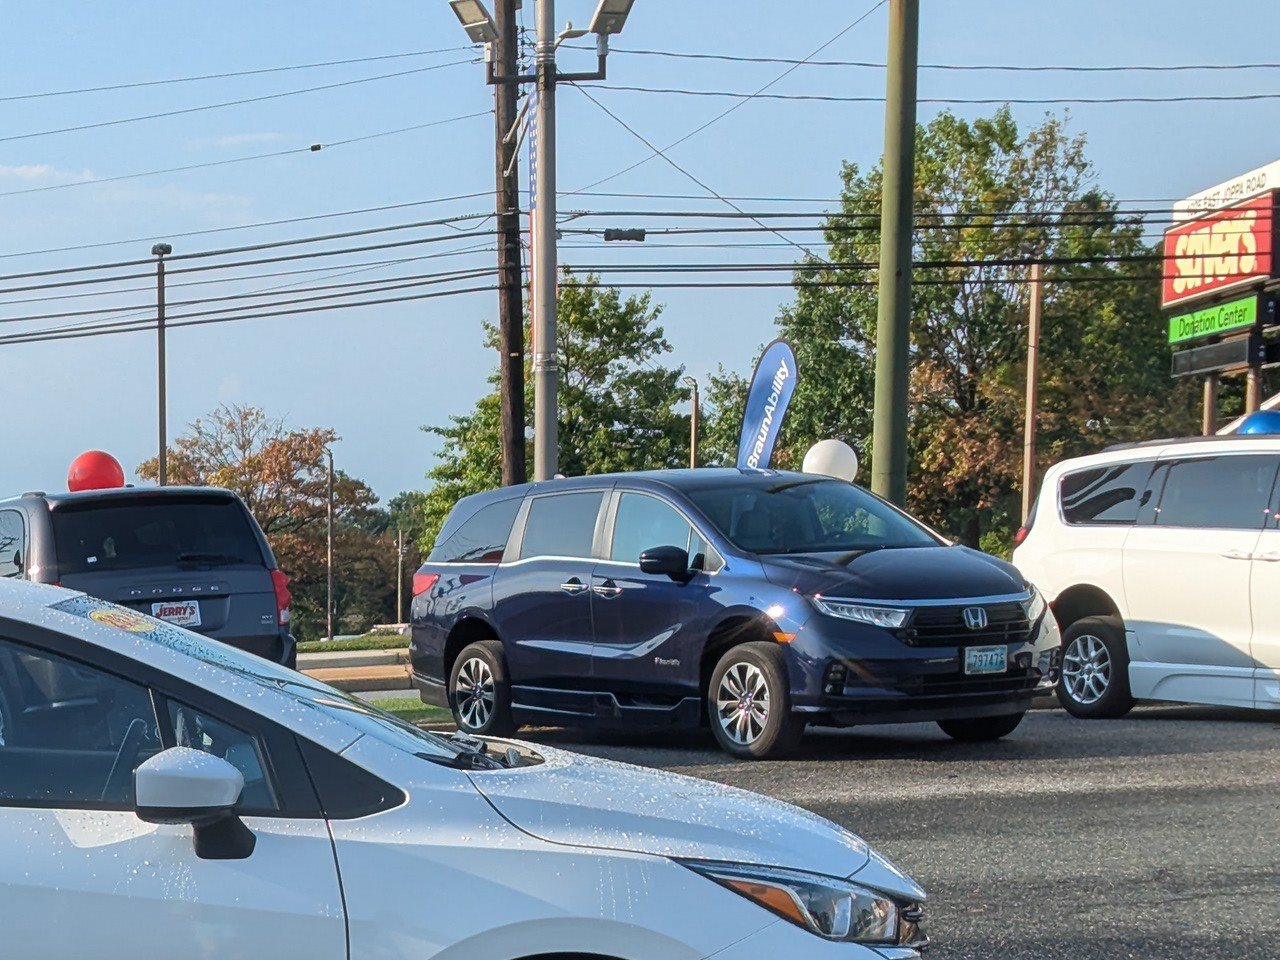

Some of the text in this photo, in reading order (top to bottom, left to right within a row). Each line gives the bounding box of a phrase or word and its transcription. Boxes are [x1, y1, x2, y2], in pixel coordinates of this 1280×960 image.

[1246, 172, 1267, 194] ROAD
[1178, 305, 1248, 337] Donation Center
[746, 356, 790, 470] BraunAbility
[155, 605, 196, 618] JERRY'S
